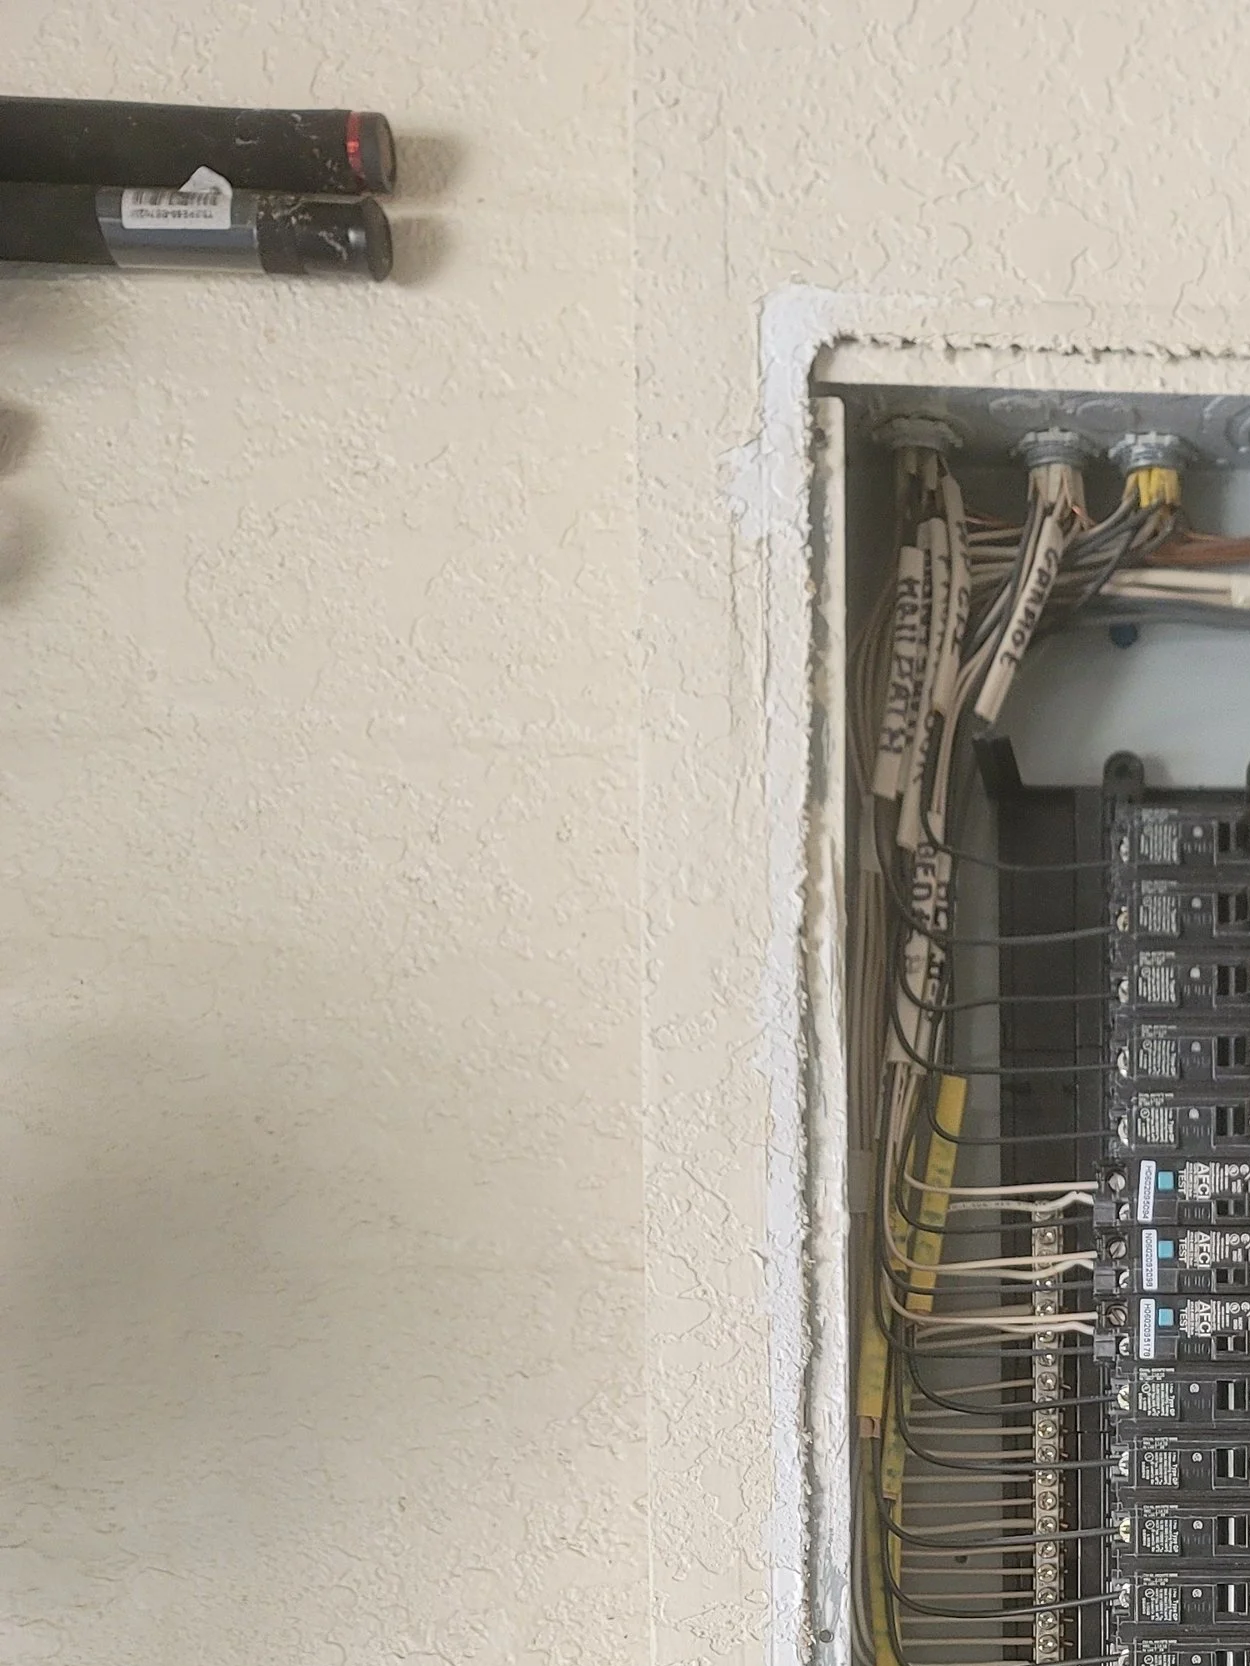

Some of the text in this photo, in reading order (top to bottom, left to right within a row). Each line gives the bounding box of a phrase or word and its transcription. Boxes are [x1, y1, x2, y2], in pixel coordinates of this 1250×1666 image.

[1178, 1169, 1186, 1193] TEST
[1198, 1163, 1209, 1199] AFCI
[1198, 1232, 1210, 1268] AFCI
[1199, 1301, 1211, 1337] AFCI
